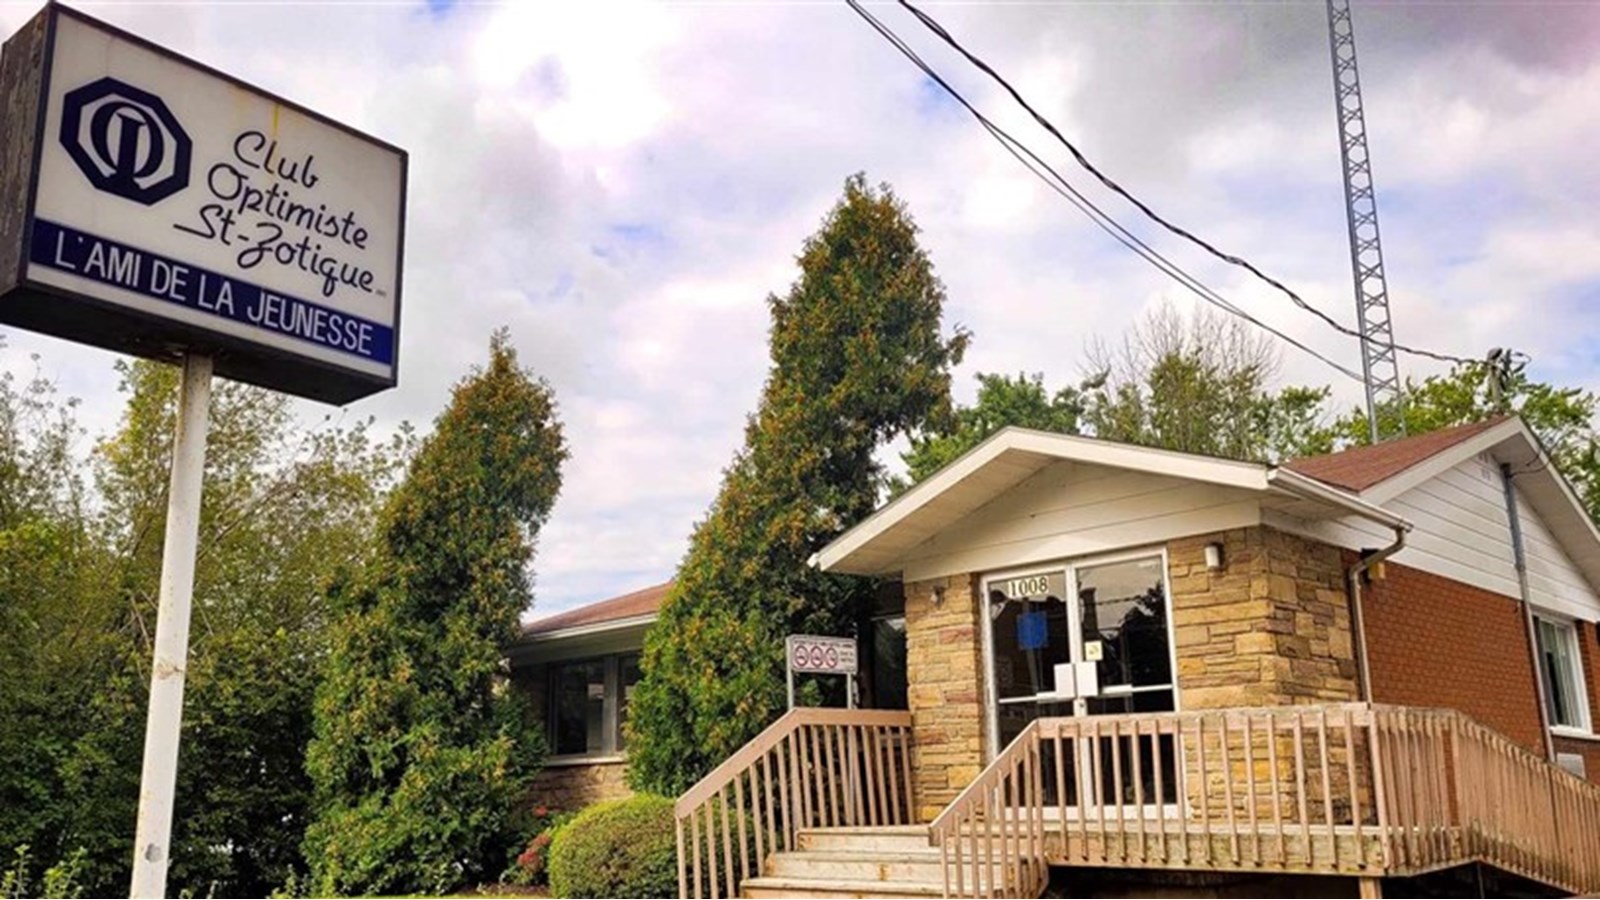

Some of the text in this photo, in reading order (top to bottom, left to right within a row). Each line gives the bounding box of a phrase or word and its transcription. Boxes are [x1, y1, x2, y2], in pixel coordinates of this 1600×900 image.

[233, 130, 319, 189] Club
[173, 203, 374, 297] St-Zotique
[207, 162, 369, 250] Optimiste
[54, 230, 373, 356] L'AMI DE LA JEUNESSE
[1011, 577, 1047, 596] 1008
